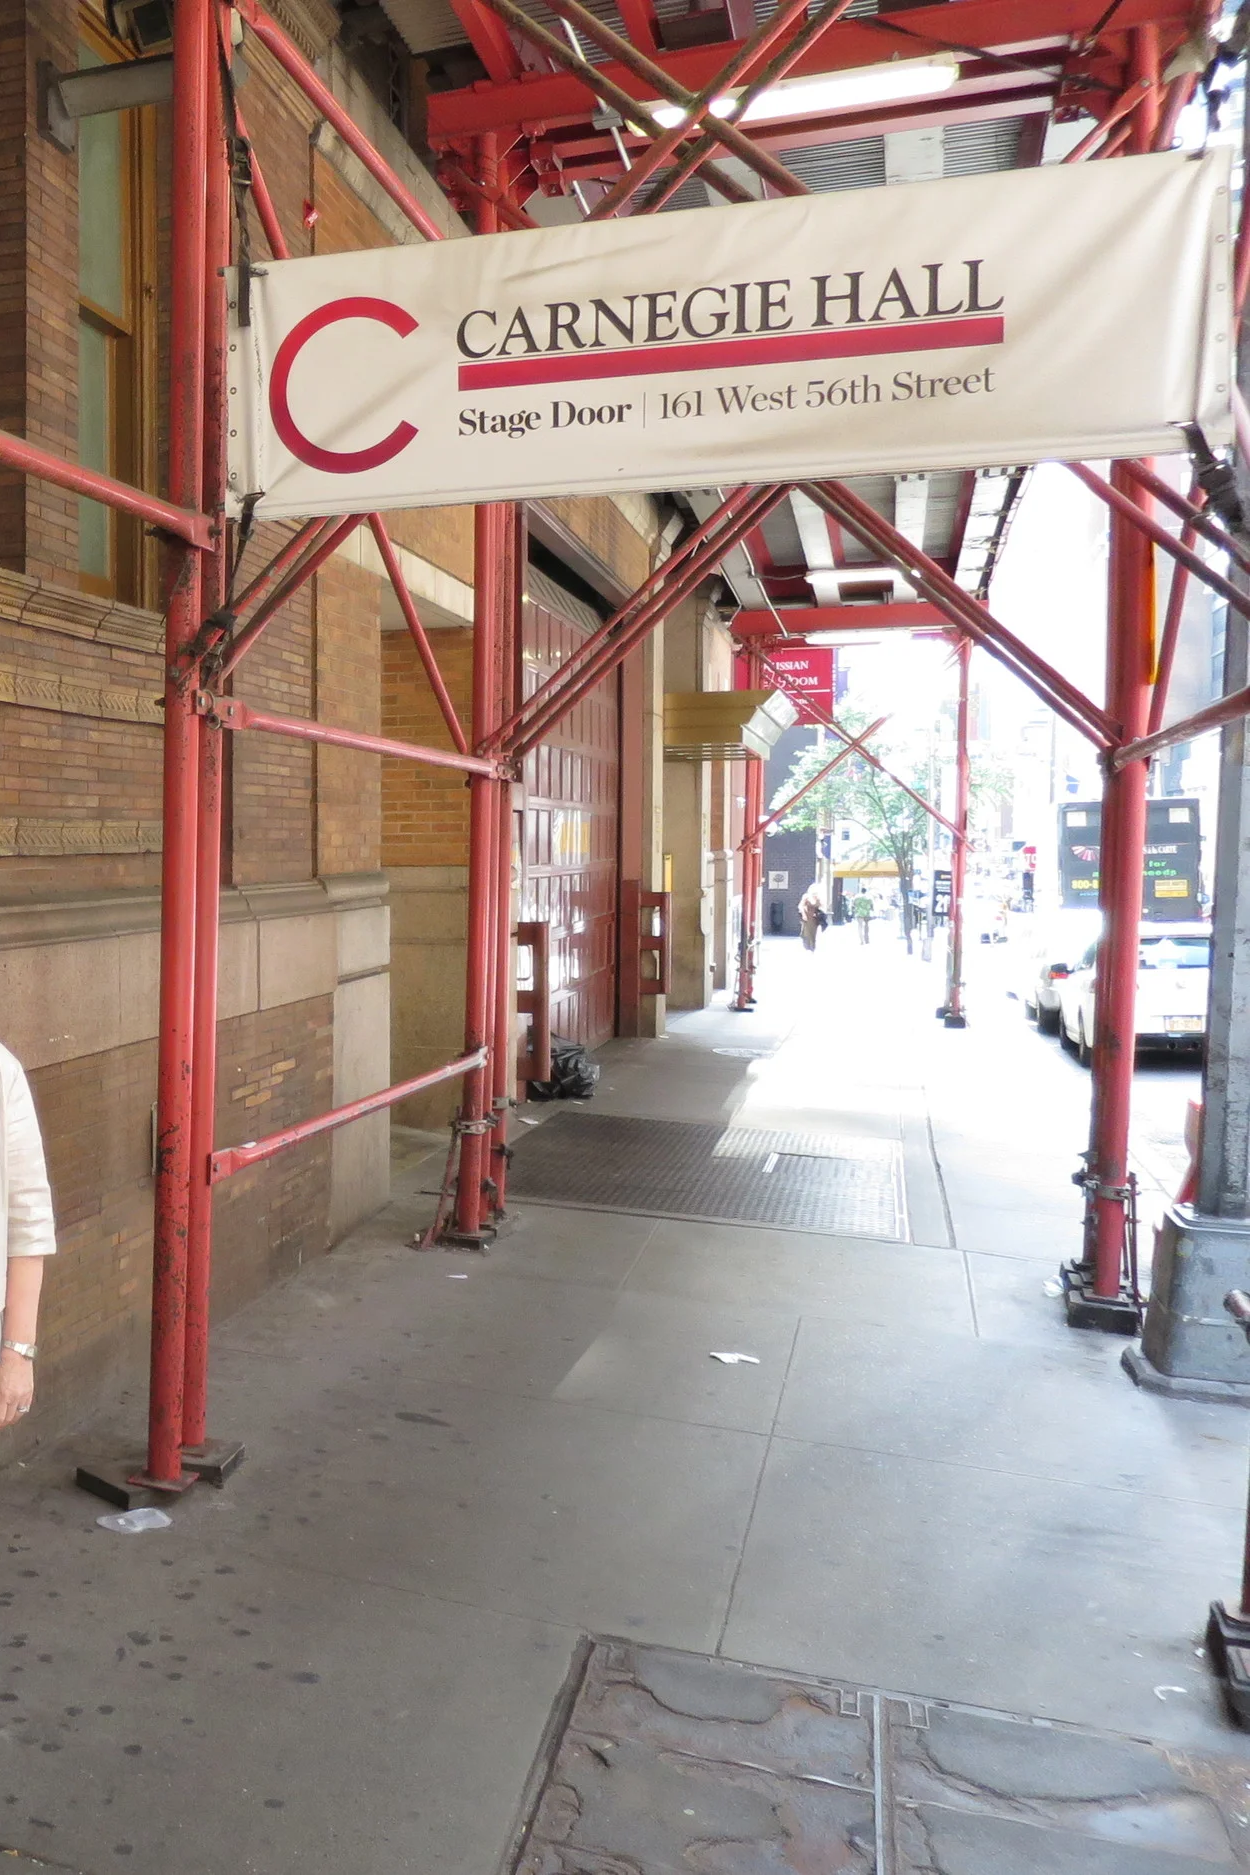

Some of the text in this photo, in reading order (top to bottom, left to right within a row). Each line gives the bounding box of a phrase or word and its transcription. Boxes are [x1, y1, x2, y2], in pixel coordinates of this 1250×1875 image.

[456, 259, 1005, 359] CARNEGIE HALL
[458, 367, 996, 440] Stage Door 161 West 56th Street
